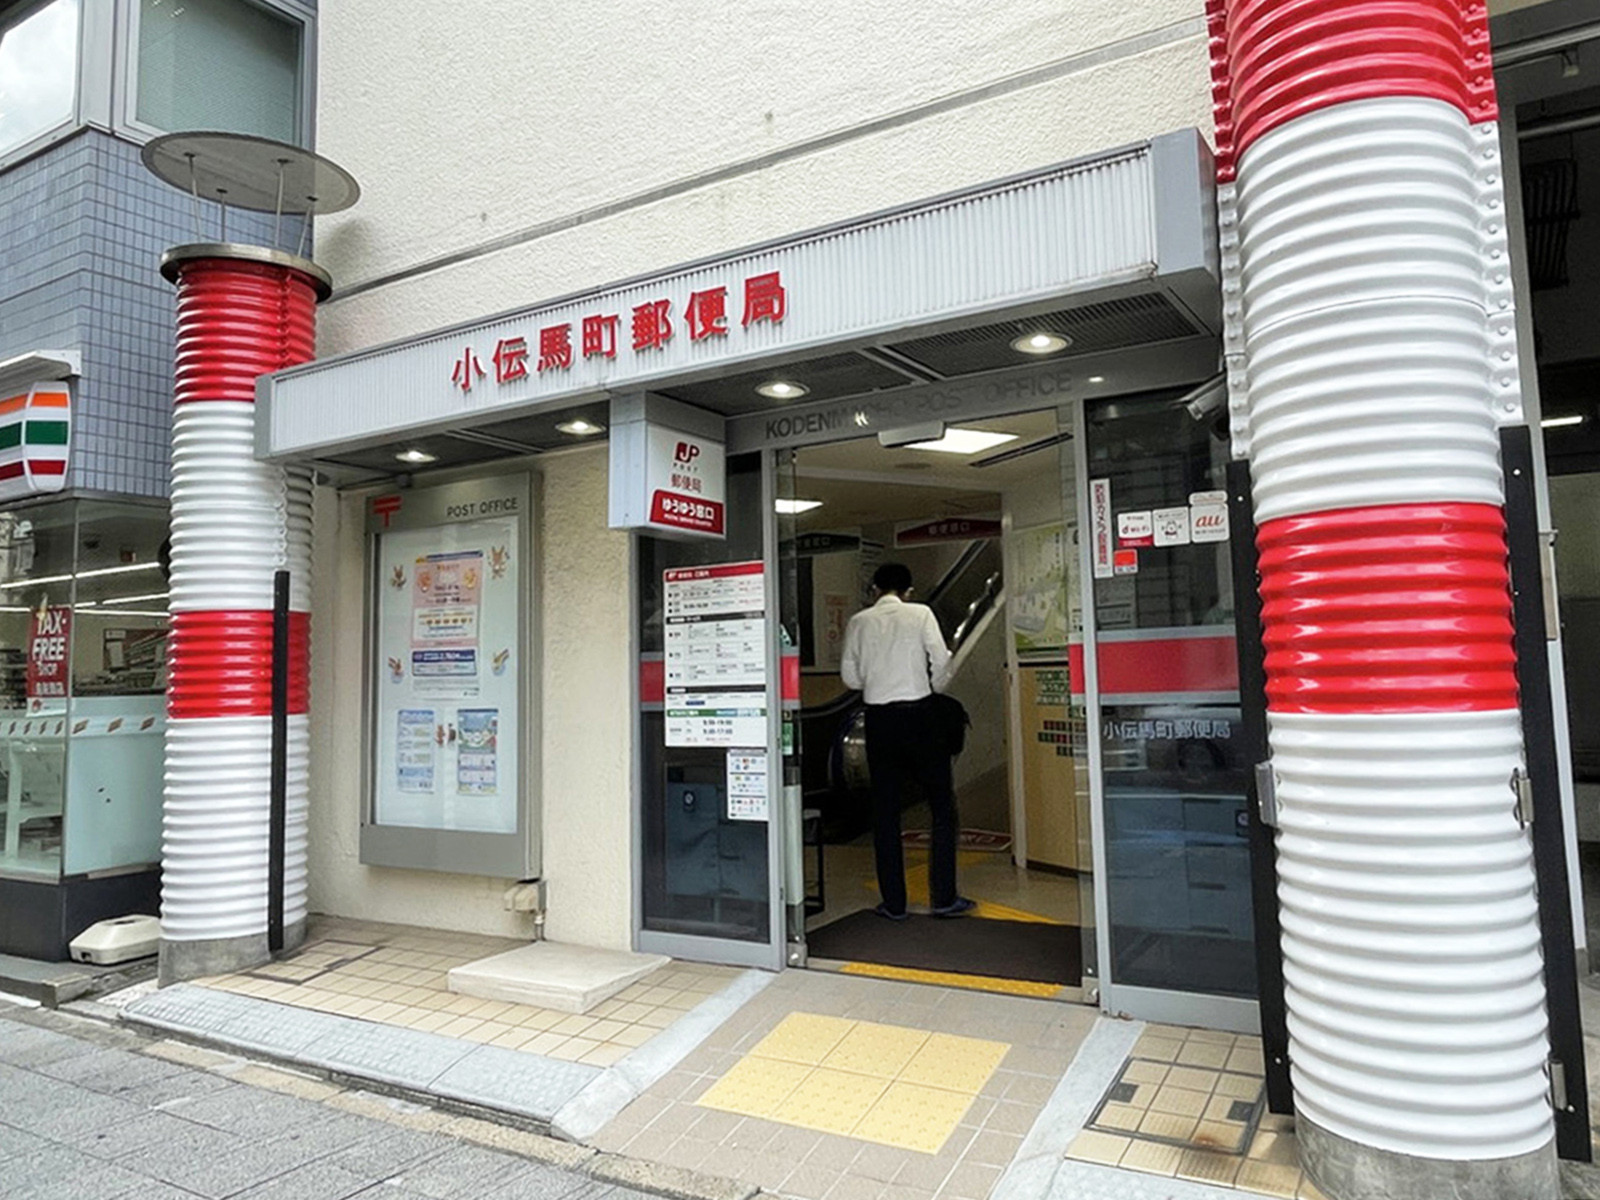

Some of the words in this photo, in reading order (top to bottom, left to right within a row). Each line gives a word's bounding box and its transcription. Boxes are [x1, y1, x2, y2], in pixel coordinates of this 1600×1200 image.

[451, 271, 786, 392] 小伝馬町郵便局
[985, 372, 1072, 403] OFFICE
[675, 441, 700, 463] JP
[447, 503, 476, 518] POST
[480, 497, 518, 514] OFFICE
[662, 497, 714, 520] ゆうゆう窓口
[1195, 515, 1225, 528] au
[32, 637, 65, 661] FREE
[1103, 719, 1231, 740] 小伝馬町郵便局
